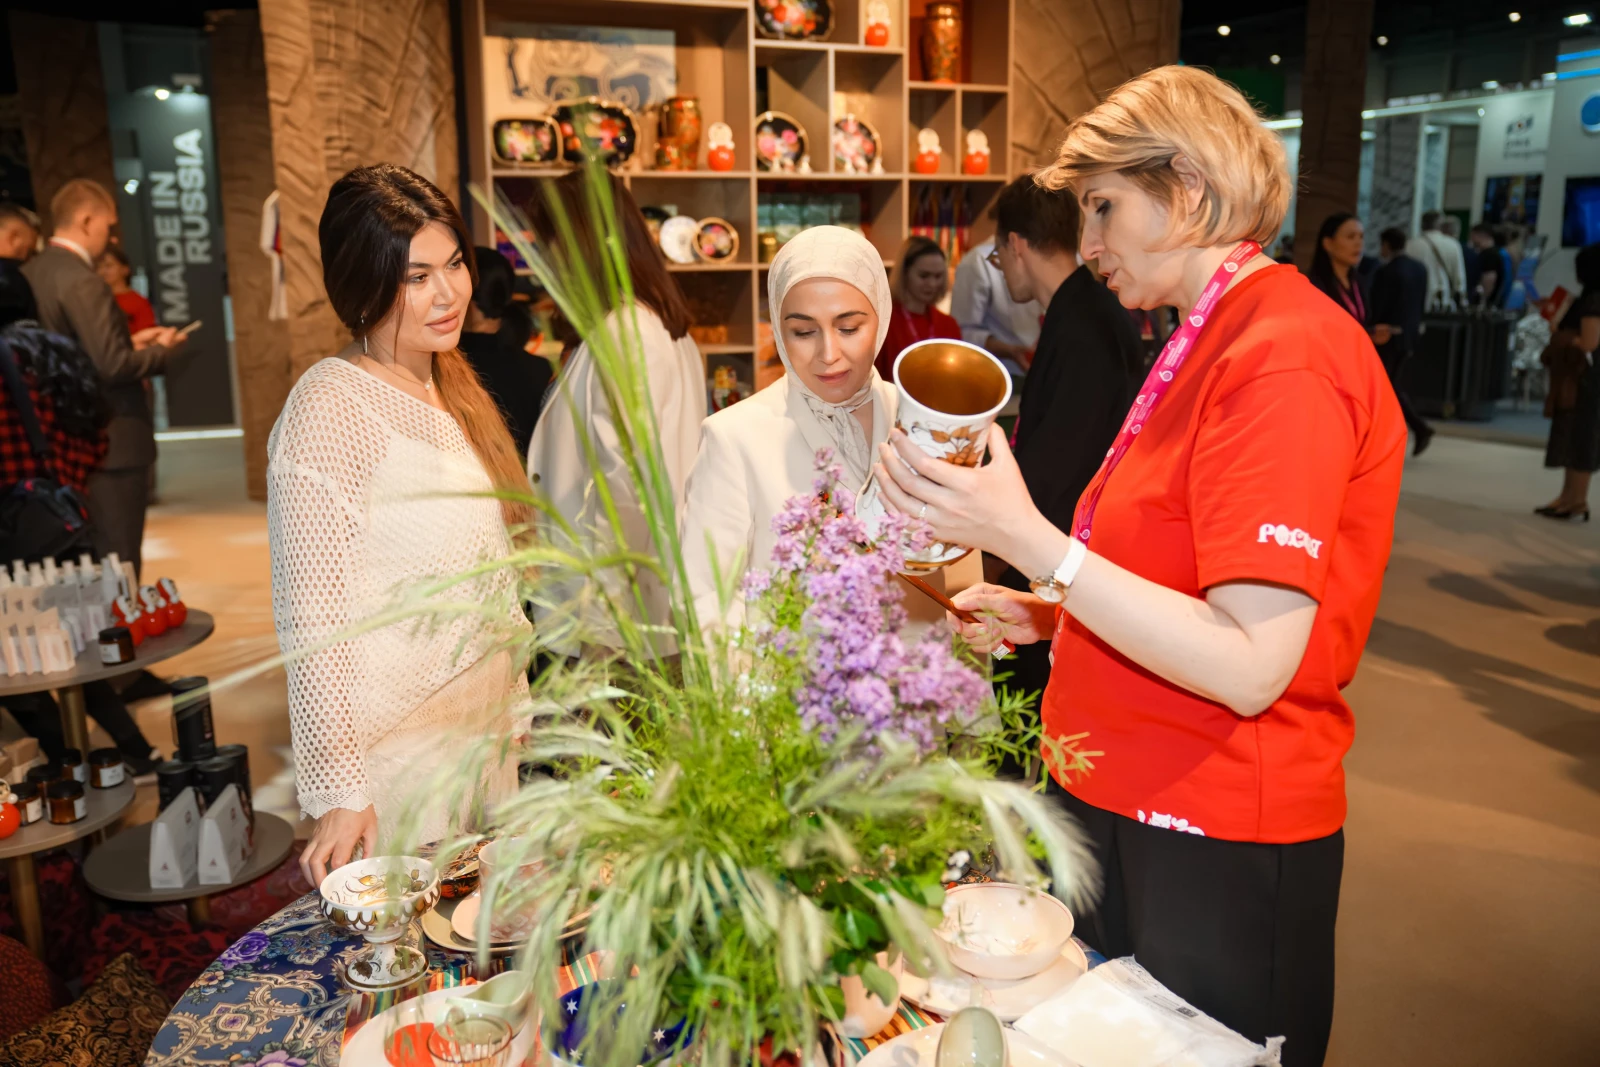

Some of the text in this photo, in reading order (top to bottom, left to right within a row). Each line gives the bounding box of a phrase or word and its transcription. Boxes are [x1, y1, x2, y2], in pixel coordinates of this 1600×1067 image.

[150, 170, 190, 323] MADE IN
[173, 128, 212, 264] RUSSIA
